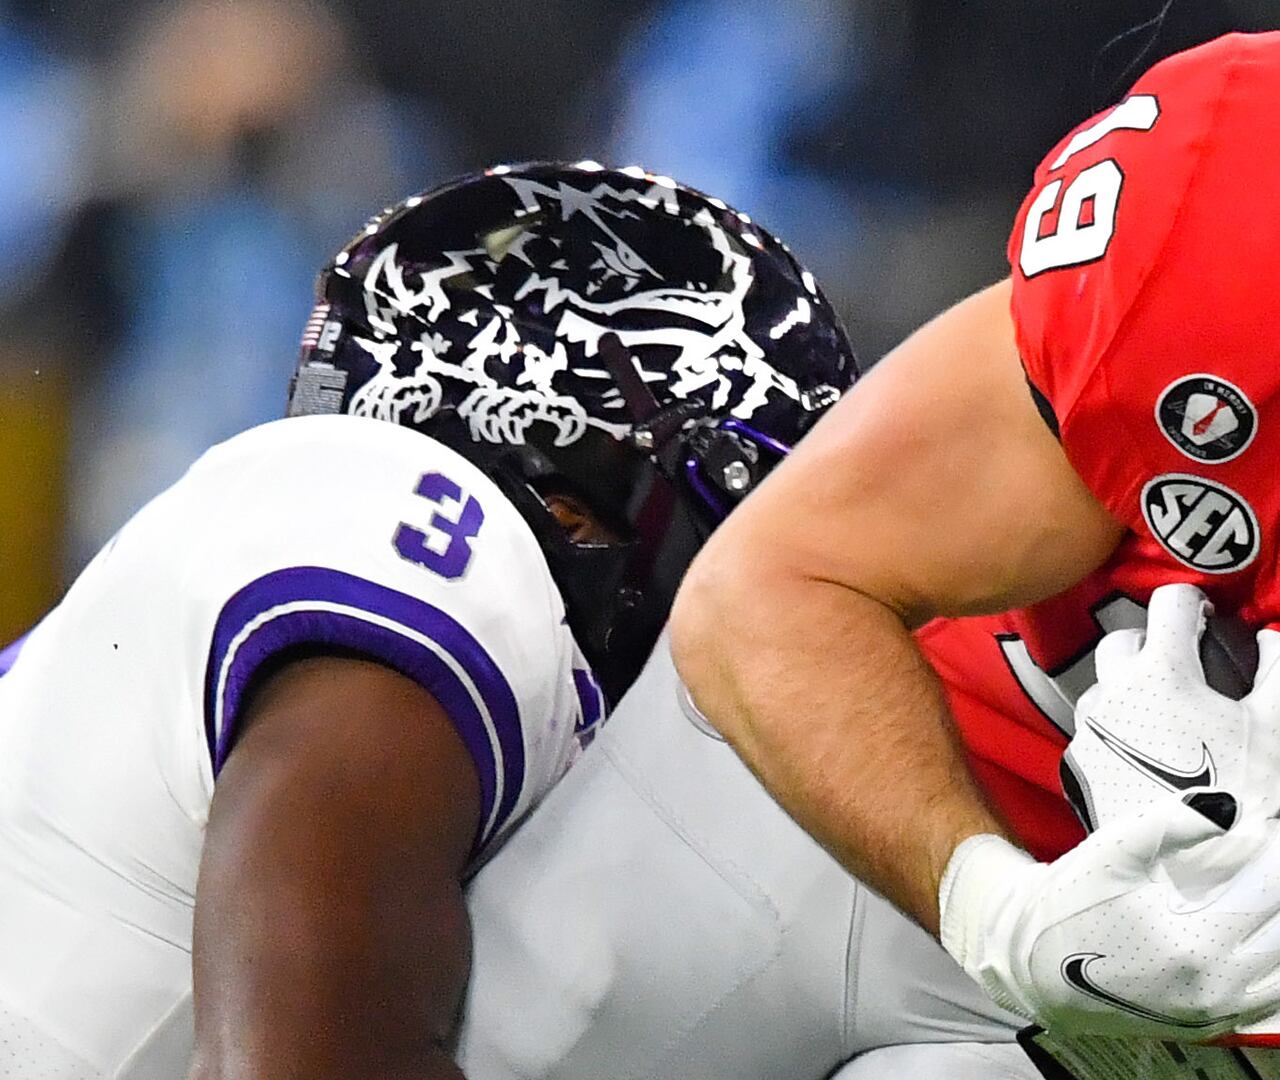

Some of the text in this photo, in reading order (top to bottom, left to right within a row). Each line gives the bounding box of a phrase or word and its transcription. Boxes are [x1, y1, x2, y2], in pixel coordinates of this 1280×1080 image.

[1019, 93, 1162, 280] 19
[391, 470, 485, 581] 3
[1149, 483, 1250, 566] SEC
